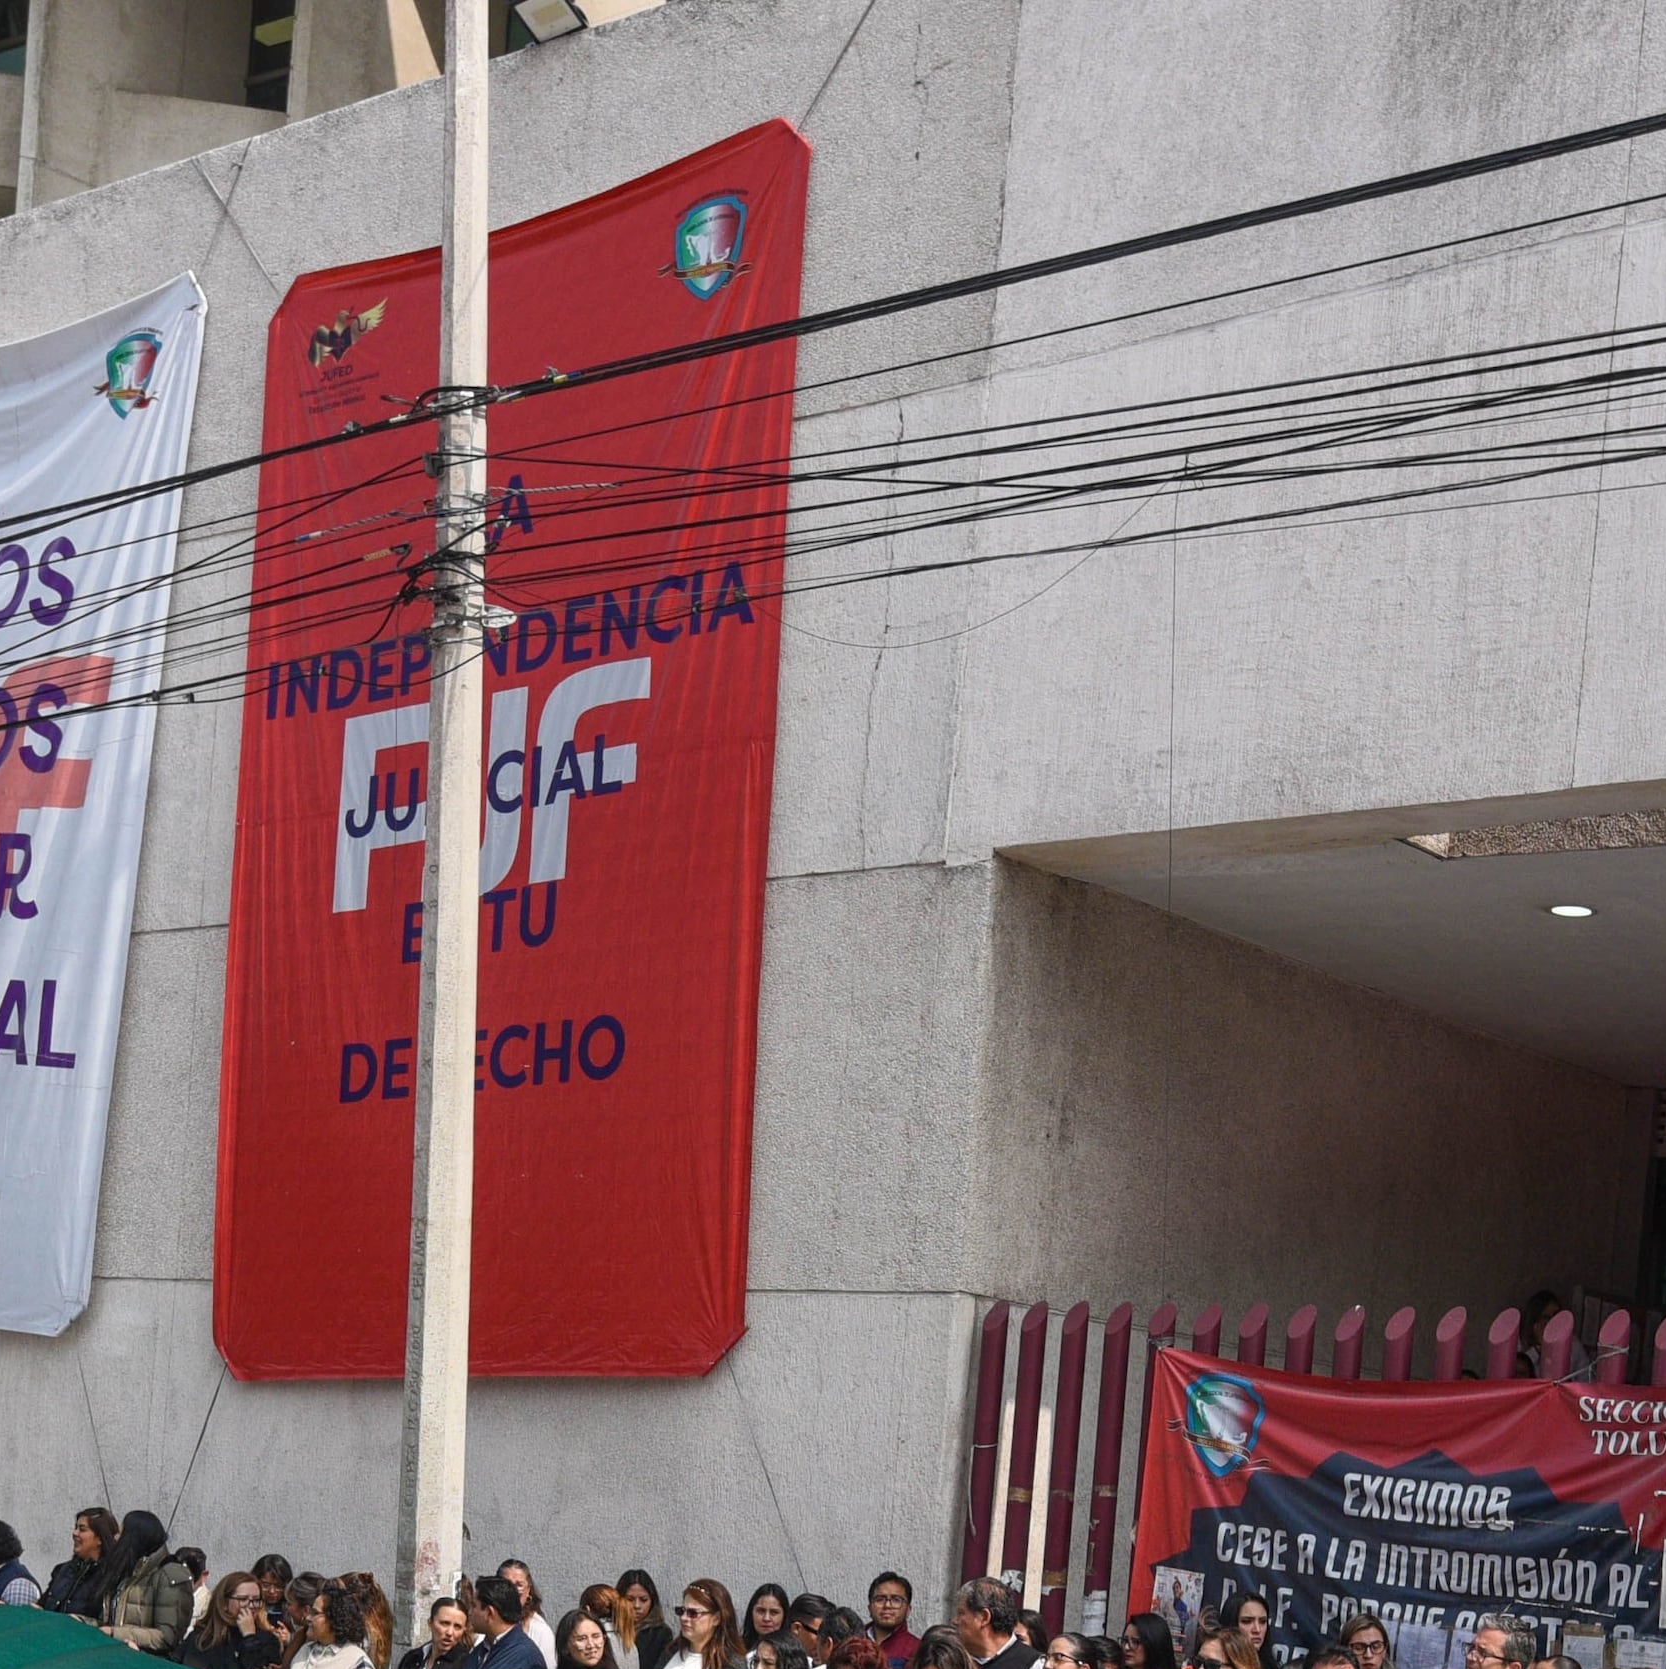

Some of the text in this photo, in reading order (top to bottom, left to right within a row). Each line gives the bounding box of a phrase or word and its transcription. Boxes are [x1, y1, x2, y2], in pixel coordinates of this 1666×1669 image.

[485, 474, 535, 552] A
[265, 561, 755, 720] INDEPNDENCIA
[345, 735, 623, 838] JUCIAL
[484, 881, 557, 953] TU
[339, 1014, 626, 1105] DEECHO
[1343, 1471, 1515, 1531] EXIGIMOS
[1217, 1521, 1289, 1571] CESE
[1296, 1531, 1315, 1576] A
[1325, 1537, 1368, 1581] LA
[1376, 1540, 1595, 1602] INTROMISIÓN
